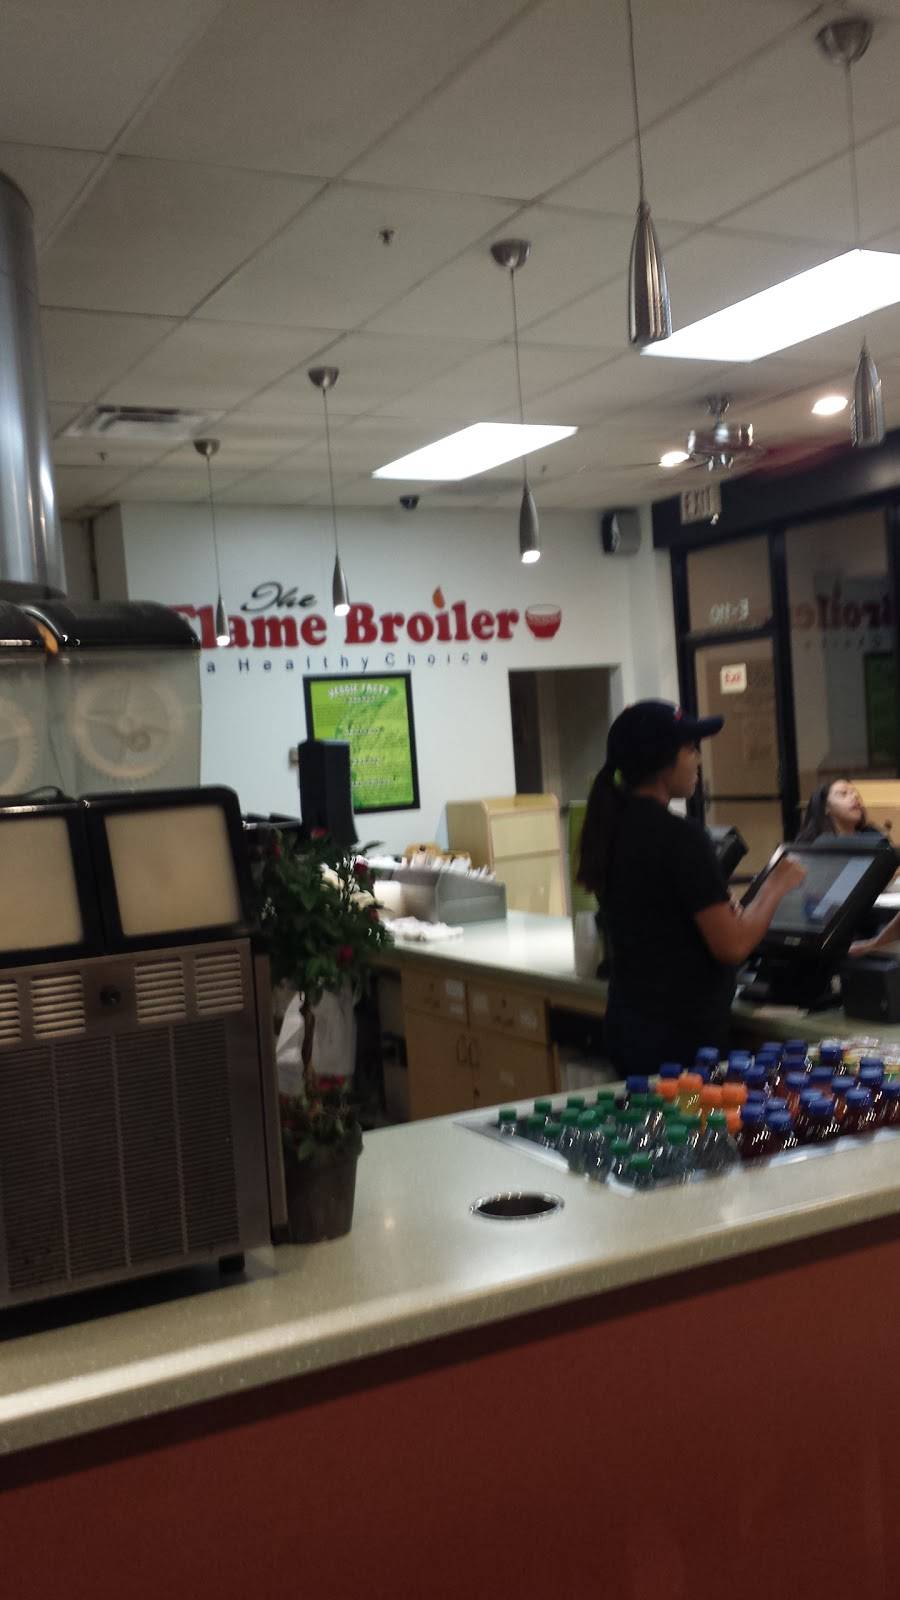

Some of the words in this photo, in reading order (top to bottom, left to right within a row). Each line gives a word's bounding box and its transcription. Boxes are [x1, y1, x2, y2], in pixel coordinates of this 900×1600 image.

[685, 487, 712, 515] EXIT
[241, 581, 318, 613] The
[344, 587, 519, 645] Broiler
[205, 661, 216, 673] a
[238, 654, 369, 675] Healthy
[384, 649, 490, 669] Choice
